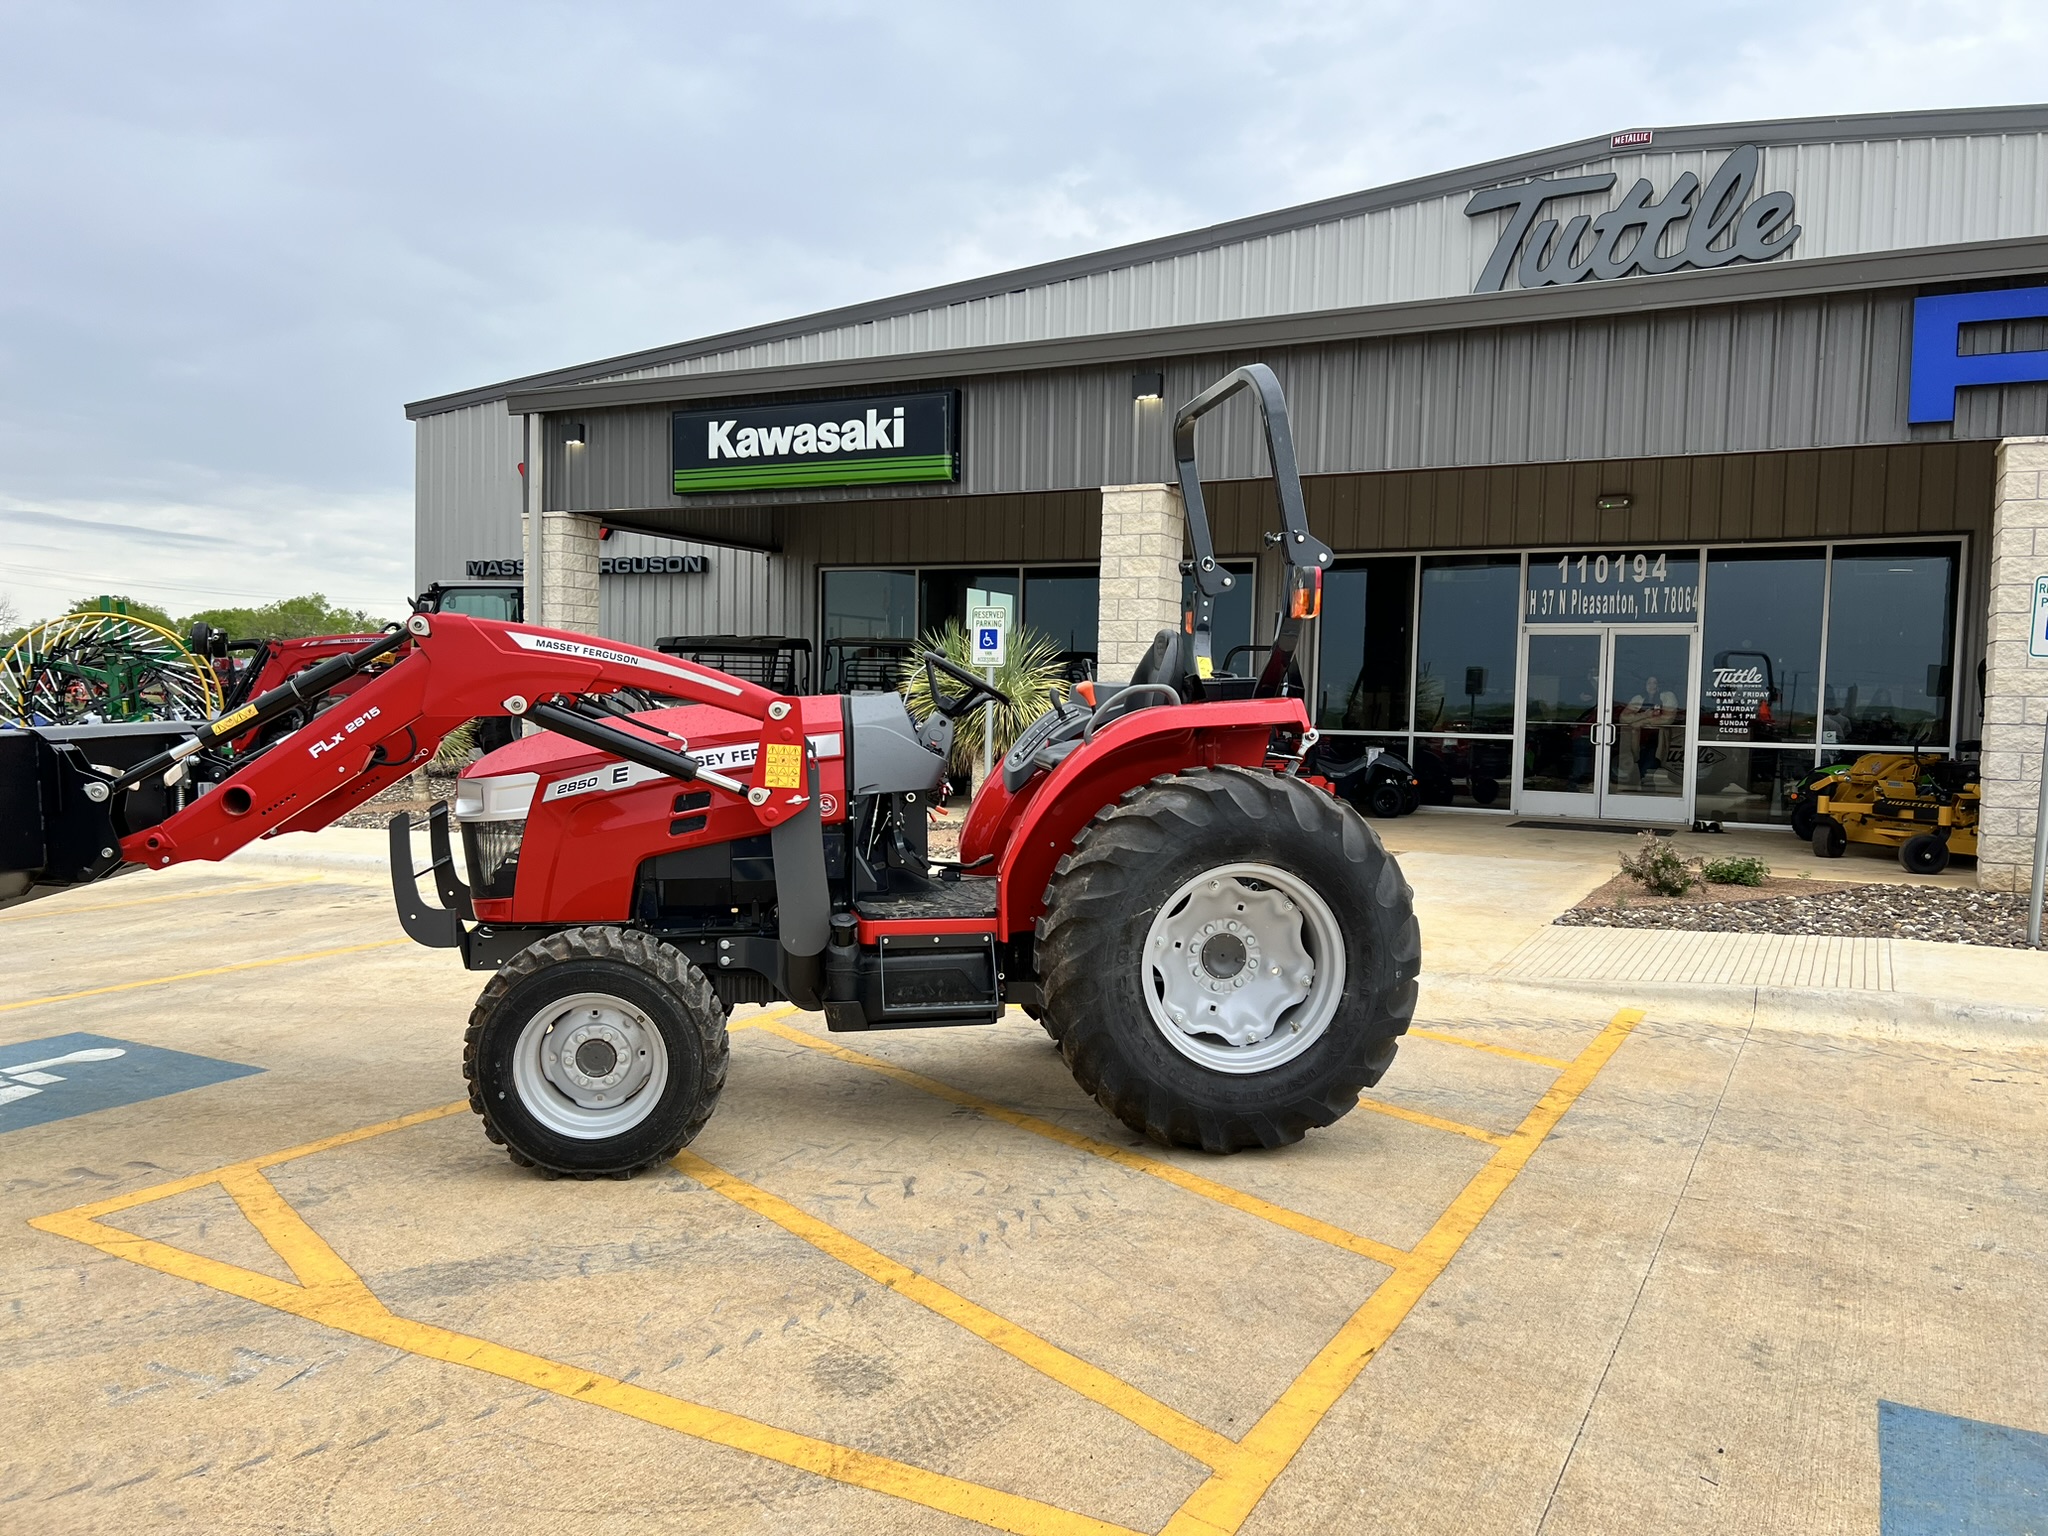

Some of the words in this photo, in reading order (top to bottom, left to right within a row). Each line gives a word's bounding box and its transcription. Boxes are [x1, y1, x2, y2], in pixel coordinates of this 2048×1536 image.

[1614, 133, 1649, 144] METALLIC
[1464, 143, 1801, 293] Tuttle
[708, 406, 904, 459] Kawasaki
[466, 559, 524, 576] MASS
[599, 556, 705, 575] RGUSON
[1558, 553, 1667, 584] 110194
[974, 610, 1004, 619] RESERVED
[1541, 589, 1555, 615] 37
[1559, 589, 1567, 615] N
[1571, 588, 1638, 620] Pleasanton,
[1644, 587, 1658, 614] TX
[1664, 585, 1698, 614] 78064
[976, 619, 1002, 628] PARKING
[536, 639, 580, 653] MASSEY
[583, 647, 639, 665] FERGUSON
[1712, 666, 1763, 688] Tuttle
[345, 706, 381, 733] 2815
[695, 752, 726, 768] SEY
[556, 777, 598, 795] 2850
[612, 766, 629, 784] E
[1886, 800, 1940, 809] HUSTLER
